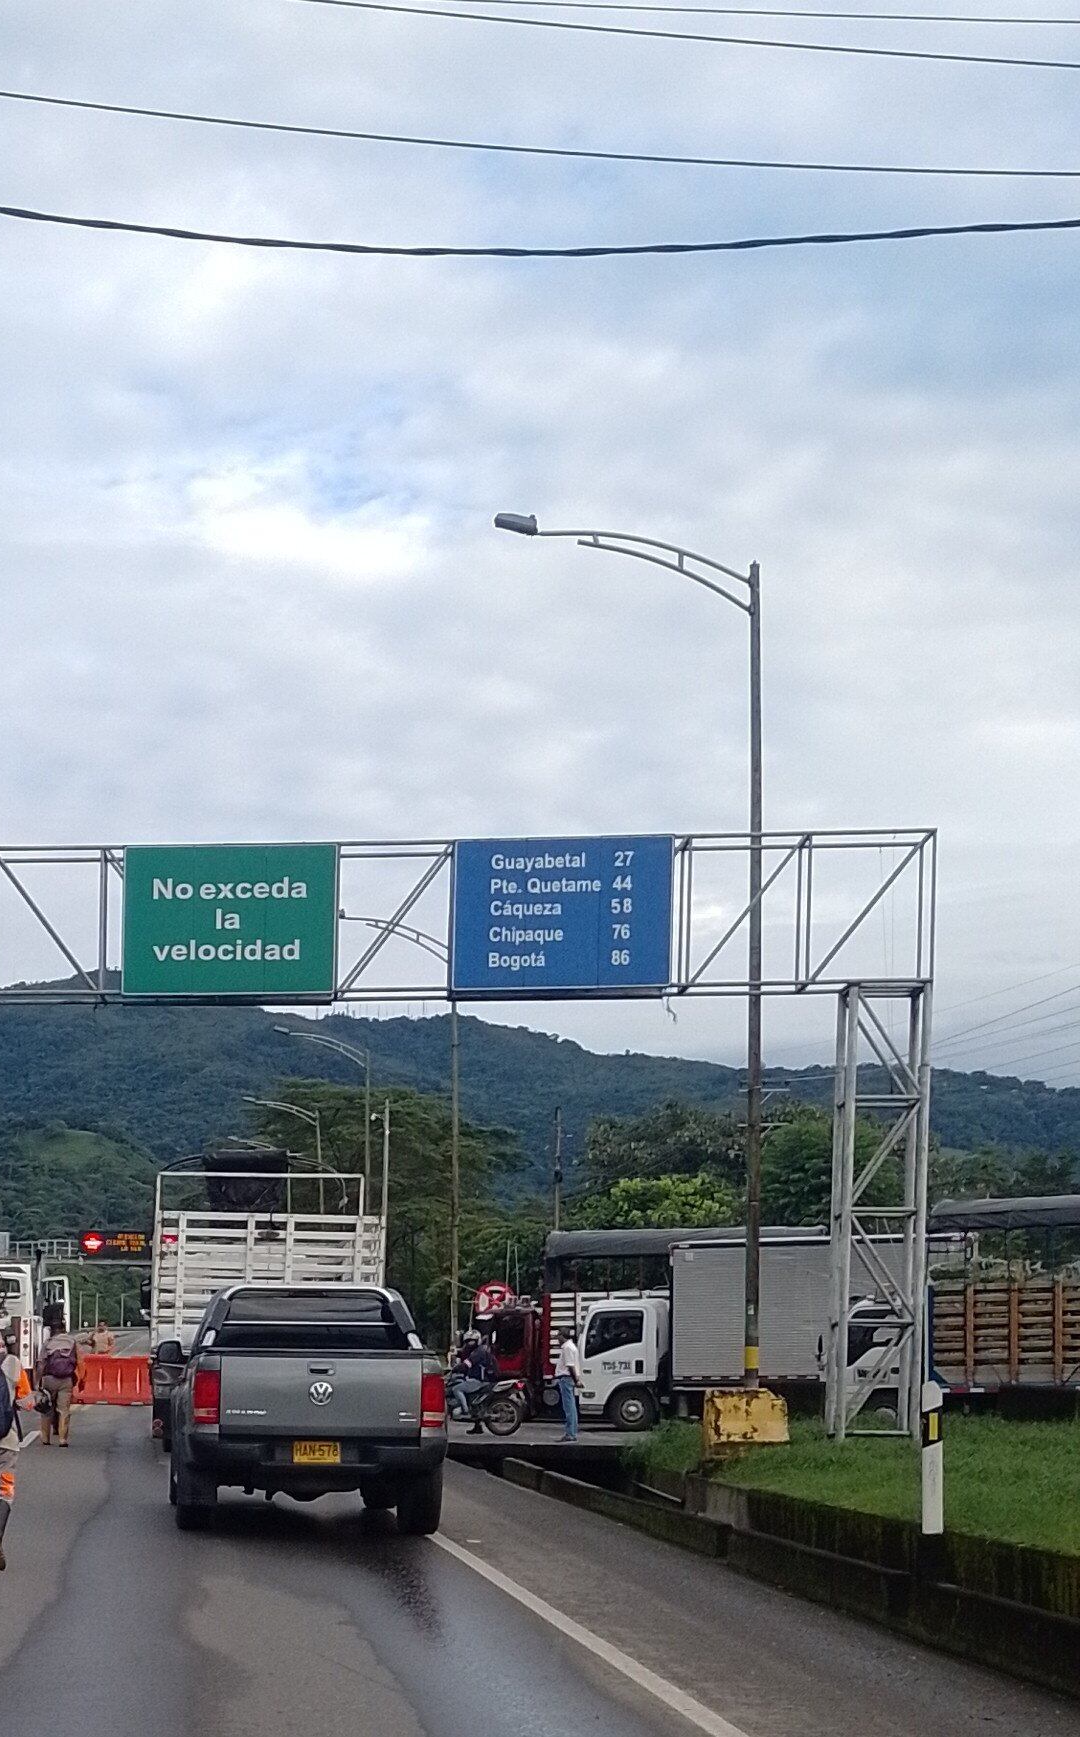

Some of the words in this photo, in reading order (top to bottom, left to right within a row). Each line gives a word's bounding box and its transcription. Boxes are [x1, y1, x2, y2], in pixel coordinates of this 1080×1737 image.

[491, 852, 586, 872] Guayabetal
[614, 850, 635, 867] 27
[152, 878, 194, 900] No
[199, 876, 308, 900] exceda
[490, 878, 522, 894] Pte.
[527, 877, 602, 894] Quetame
[612, 874, 632, 891] 44
[215, 908, 241, 930] la
[490, 901, 562, 919] Cáqueza
[611, 898, 633, 914] 58
[489, 927, 564, 946] Chipaque
[612, 923, 631, 940] 76
[152, 938, 301, 961] velocidad
[488, 951, 546, 971] Bogotá
[611, 949, 630, 966] 86
